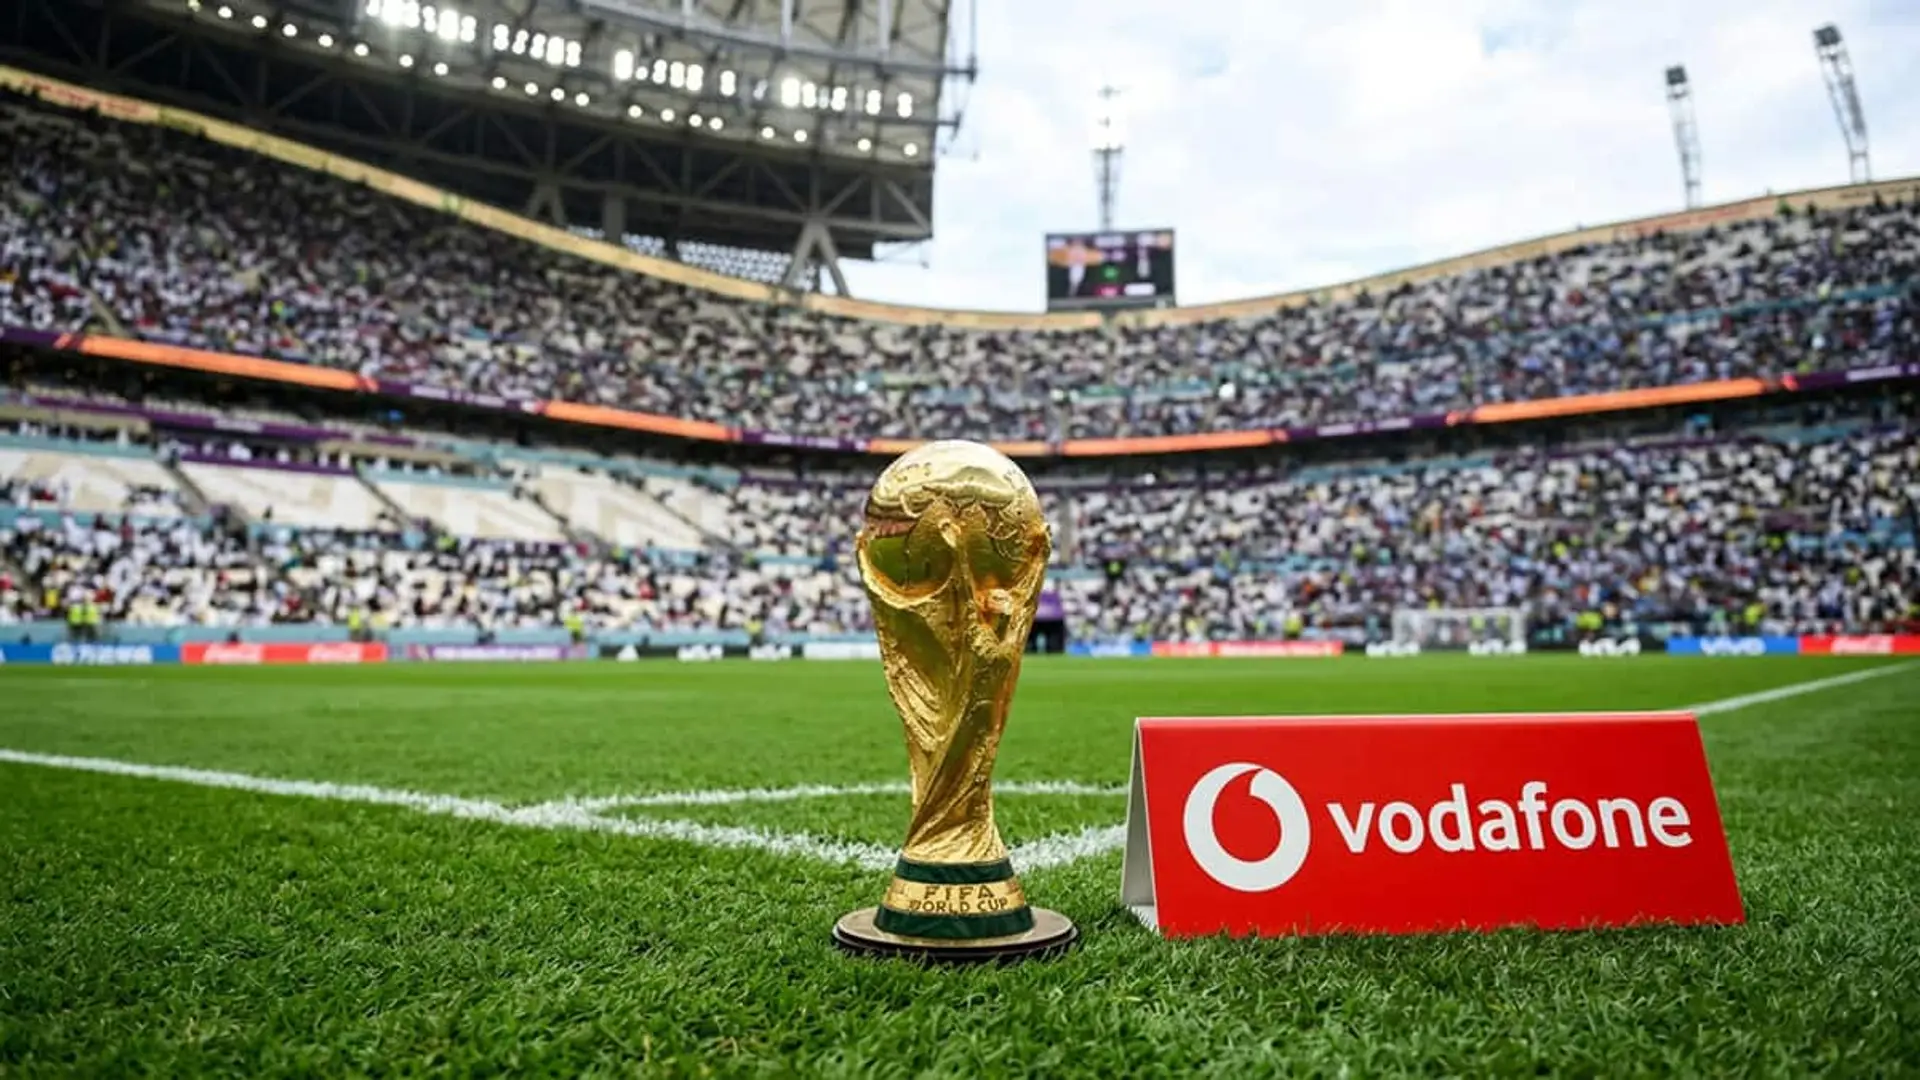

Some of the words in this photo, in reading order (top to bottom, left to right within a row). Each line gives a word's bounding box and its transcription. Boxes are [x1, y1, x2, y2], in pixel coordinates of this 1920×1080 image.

[1326, 781, 1693, 853] vodafone
[924, 885, 995, 900] FIFA
[977, 898, 1009, 912] CUP
